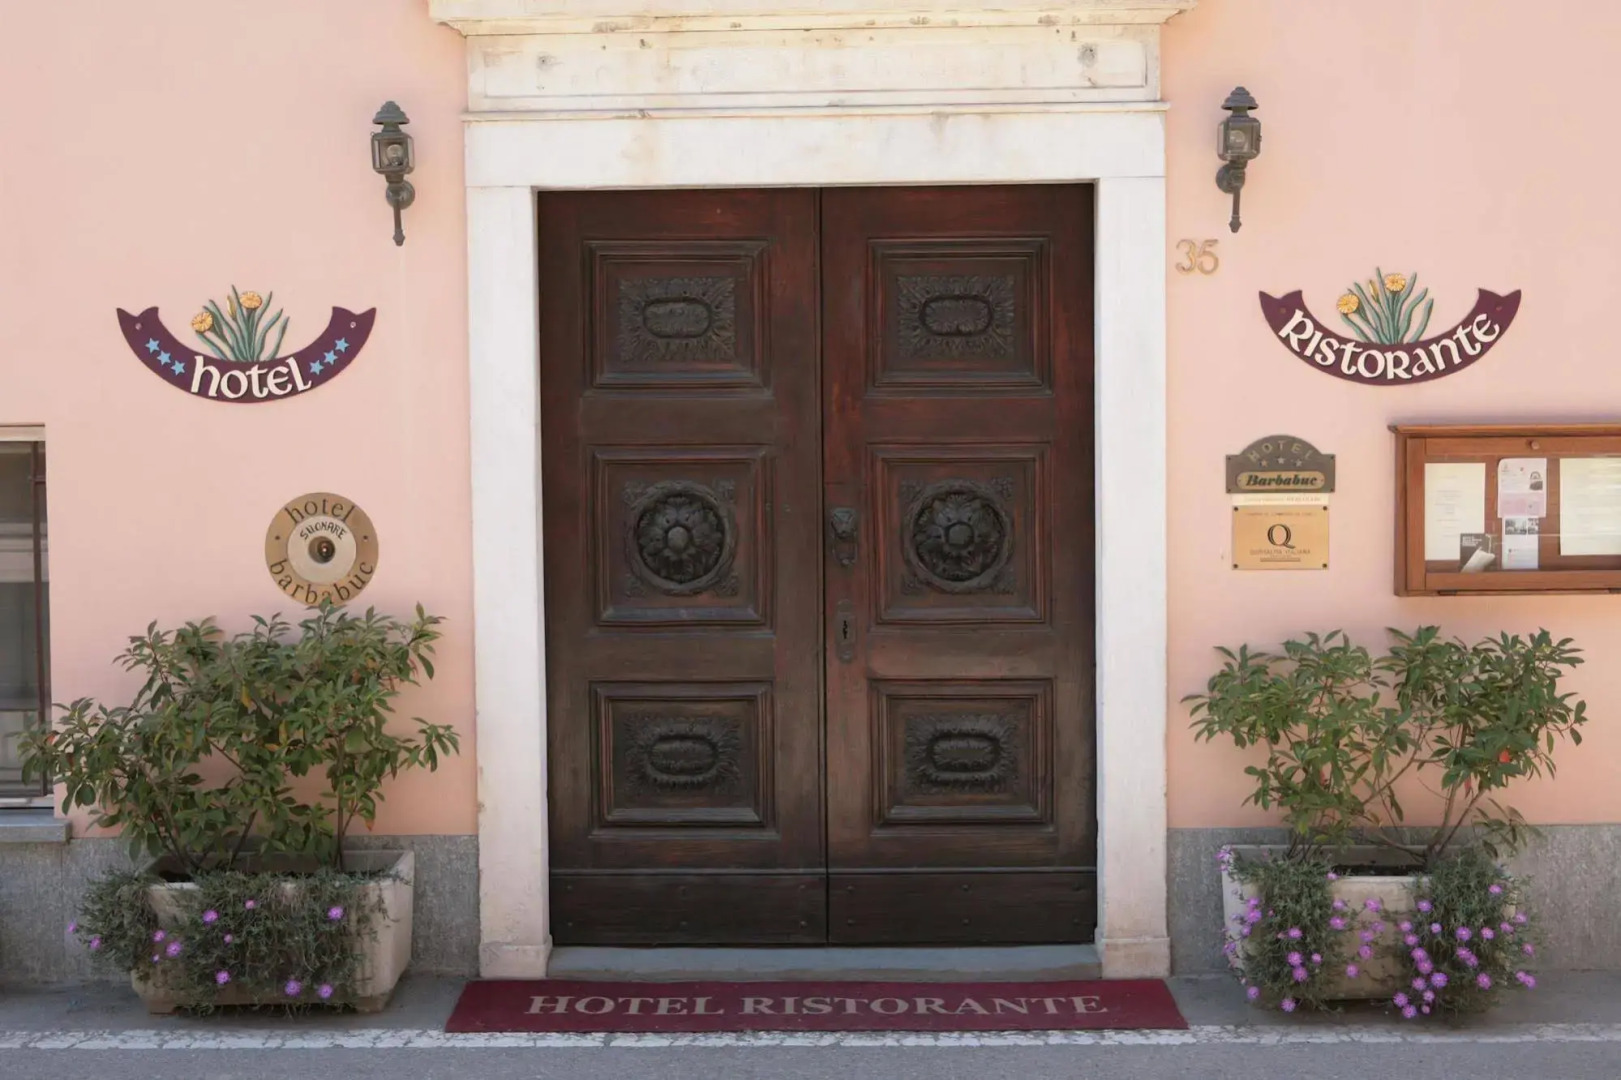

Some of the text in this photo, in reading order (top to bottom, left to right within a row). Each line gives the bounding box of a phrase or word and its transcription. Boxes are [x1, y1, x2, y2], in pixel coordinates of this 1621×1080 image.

[1175, 239, 1219, 276] 35
[190, 355, 312, 399] hotel
[1247, 440, 1314, 462] HOTEL
[1245, 474, 1318, 487] Barbabuc
[284, 498, 355, 524] hotel
[1267, 523, 1296, 549] Q
[523, 994, 1109, 1017] HOTEL RISTORANTE
